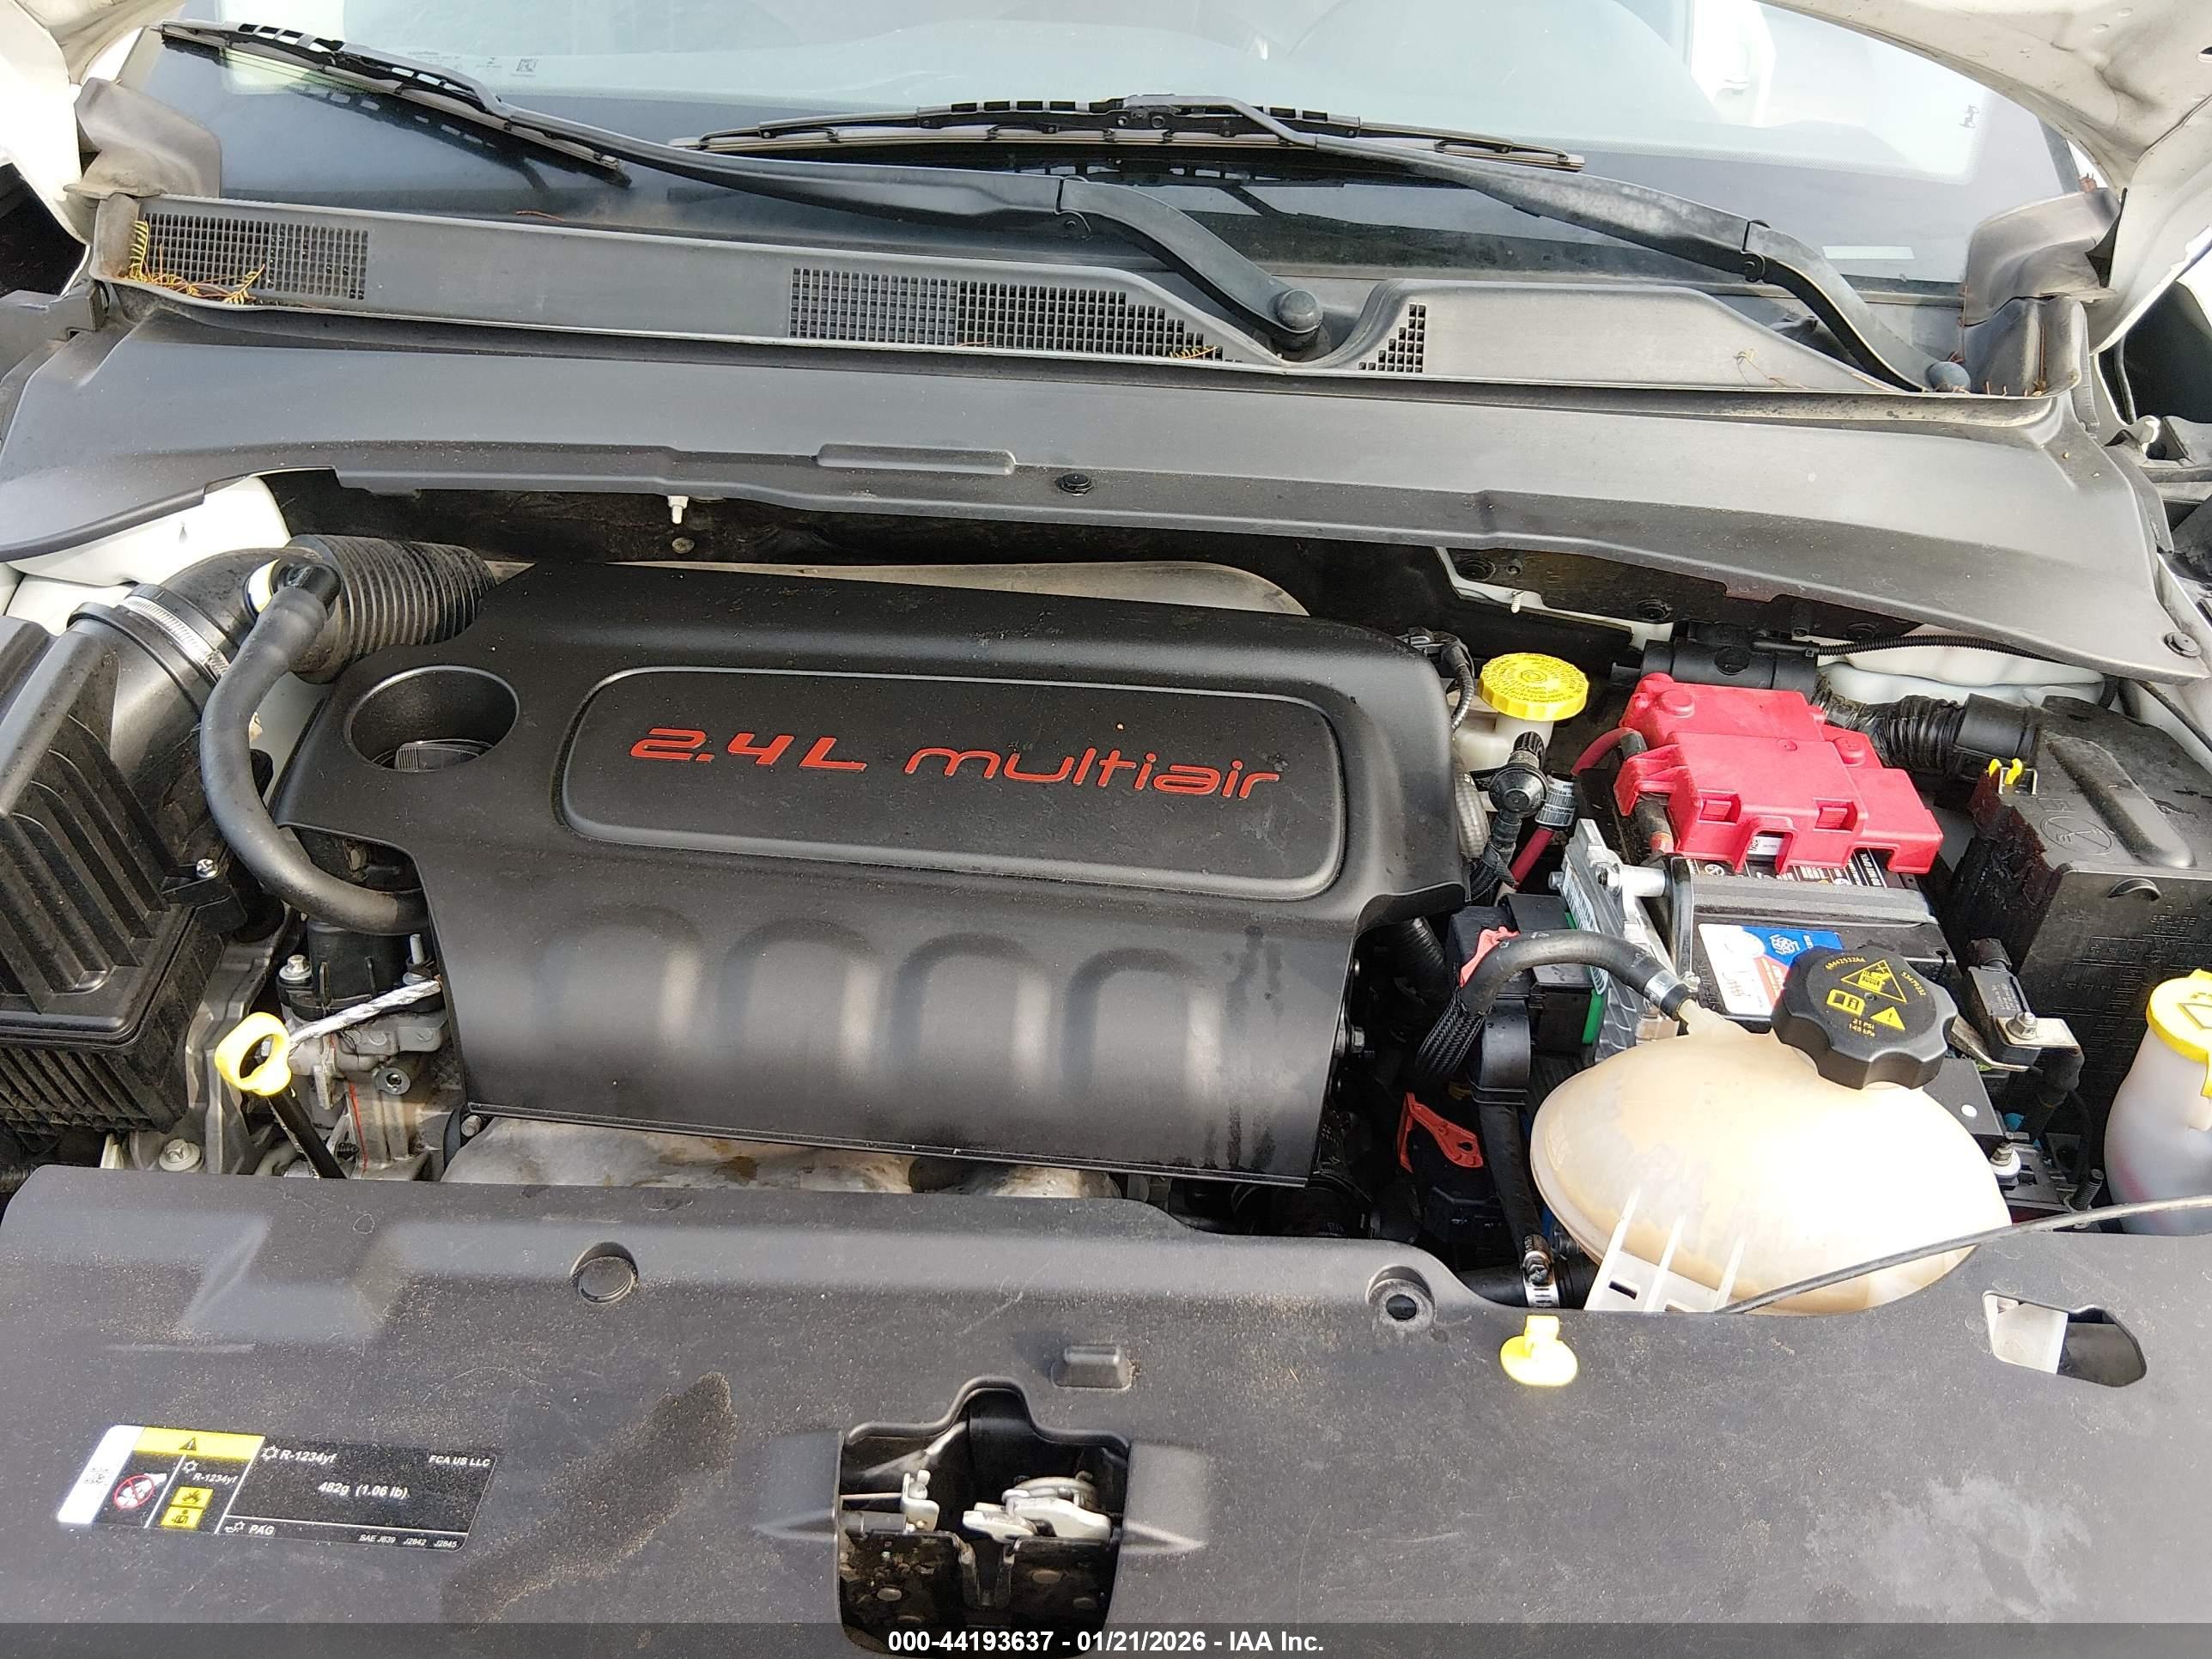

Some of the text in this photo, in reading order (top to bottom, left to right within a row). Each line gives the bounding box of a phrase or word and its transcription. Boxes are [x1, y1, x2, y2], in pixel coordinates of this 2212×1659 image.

[902, 745, 1282, 800] multiair
[279, 1449, 338, 1465] R-1234yf
[428, 1455, 492, 1468] FCA US LLC
[317, 1481, 409, 1500] 482g (1.06 lb)
[247, 1523, 276, 1536] PAG
[357, 1533, 377, 1543] SAE
